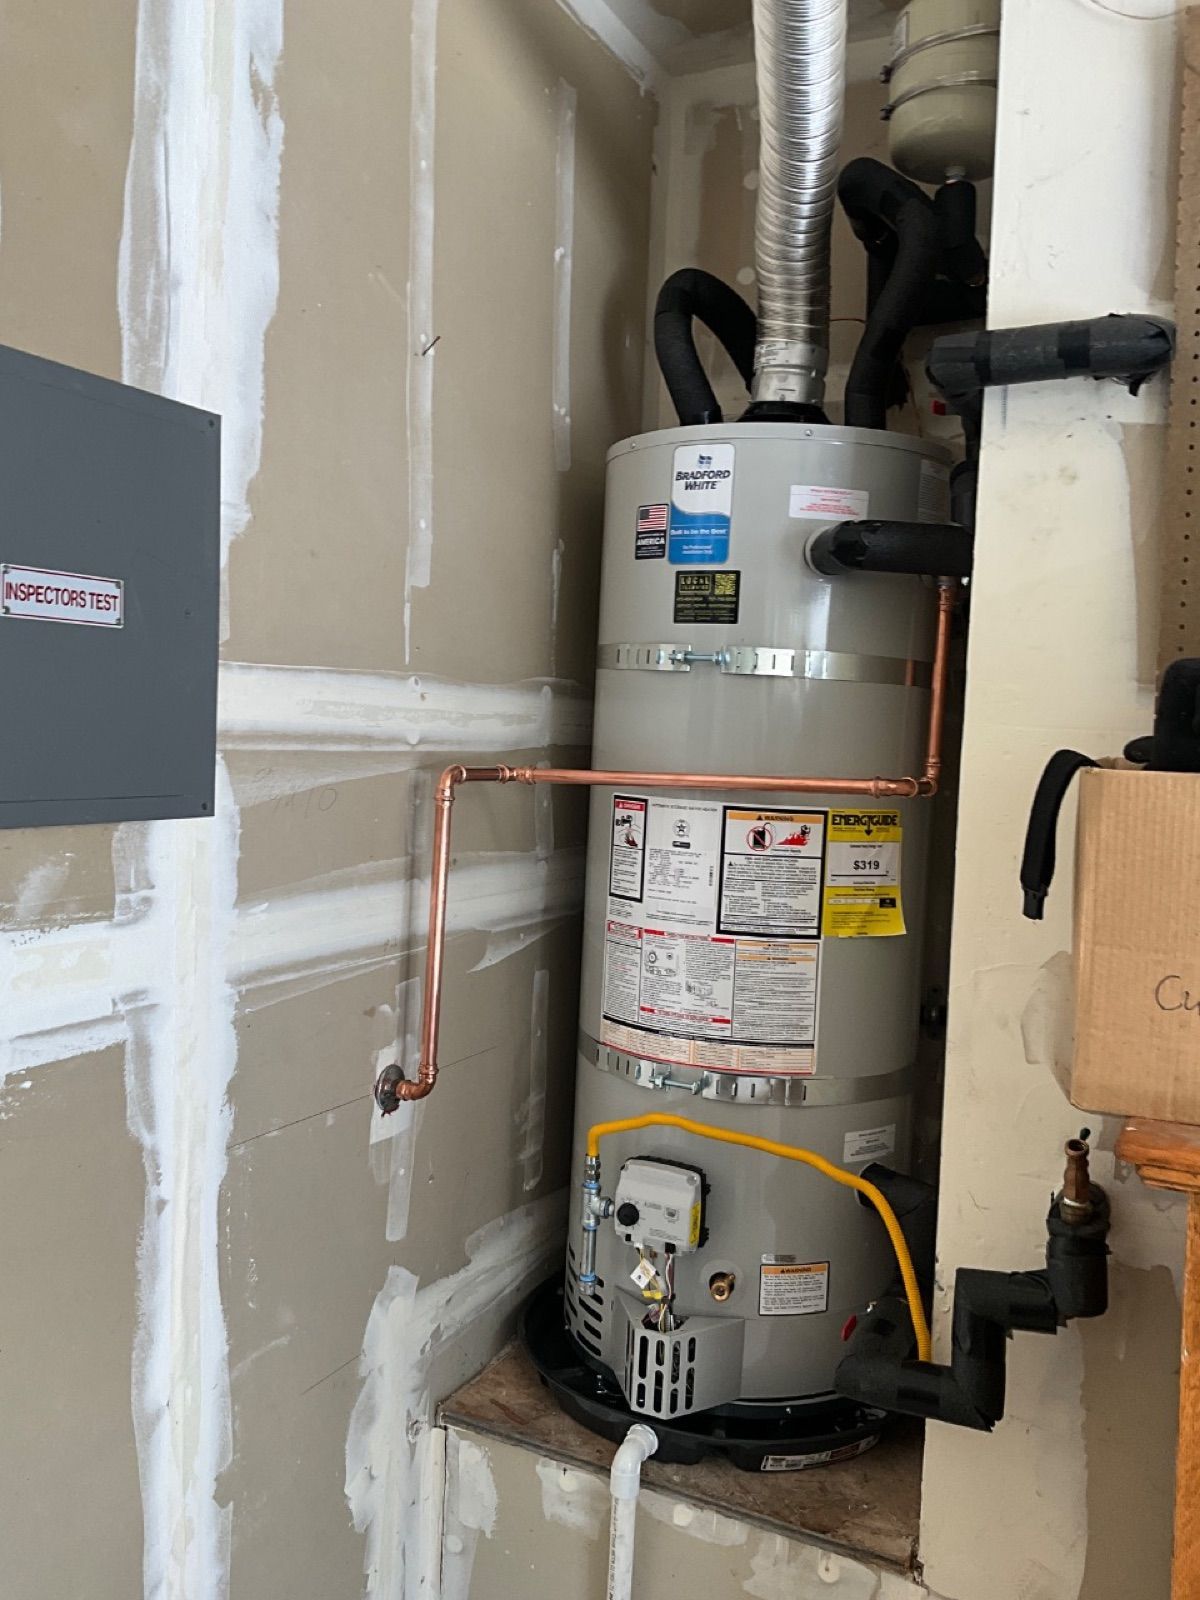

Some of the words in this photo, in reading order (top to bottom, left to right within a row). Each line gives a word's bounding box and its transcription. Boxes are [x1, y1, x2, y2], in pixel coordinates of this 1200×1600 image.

[675, 470, 731, 481] BRADFORD
[684, 481, 717, 491] WHITE
[637, 538, 665, 546] AMERICA
[5, 581, 87, 608] INSPECTORS
[89, 592, 119, 612] TEST
[853, 860, 880, 871] $319
